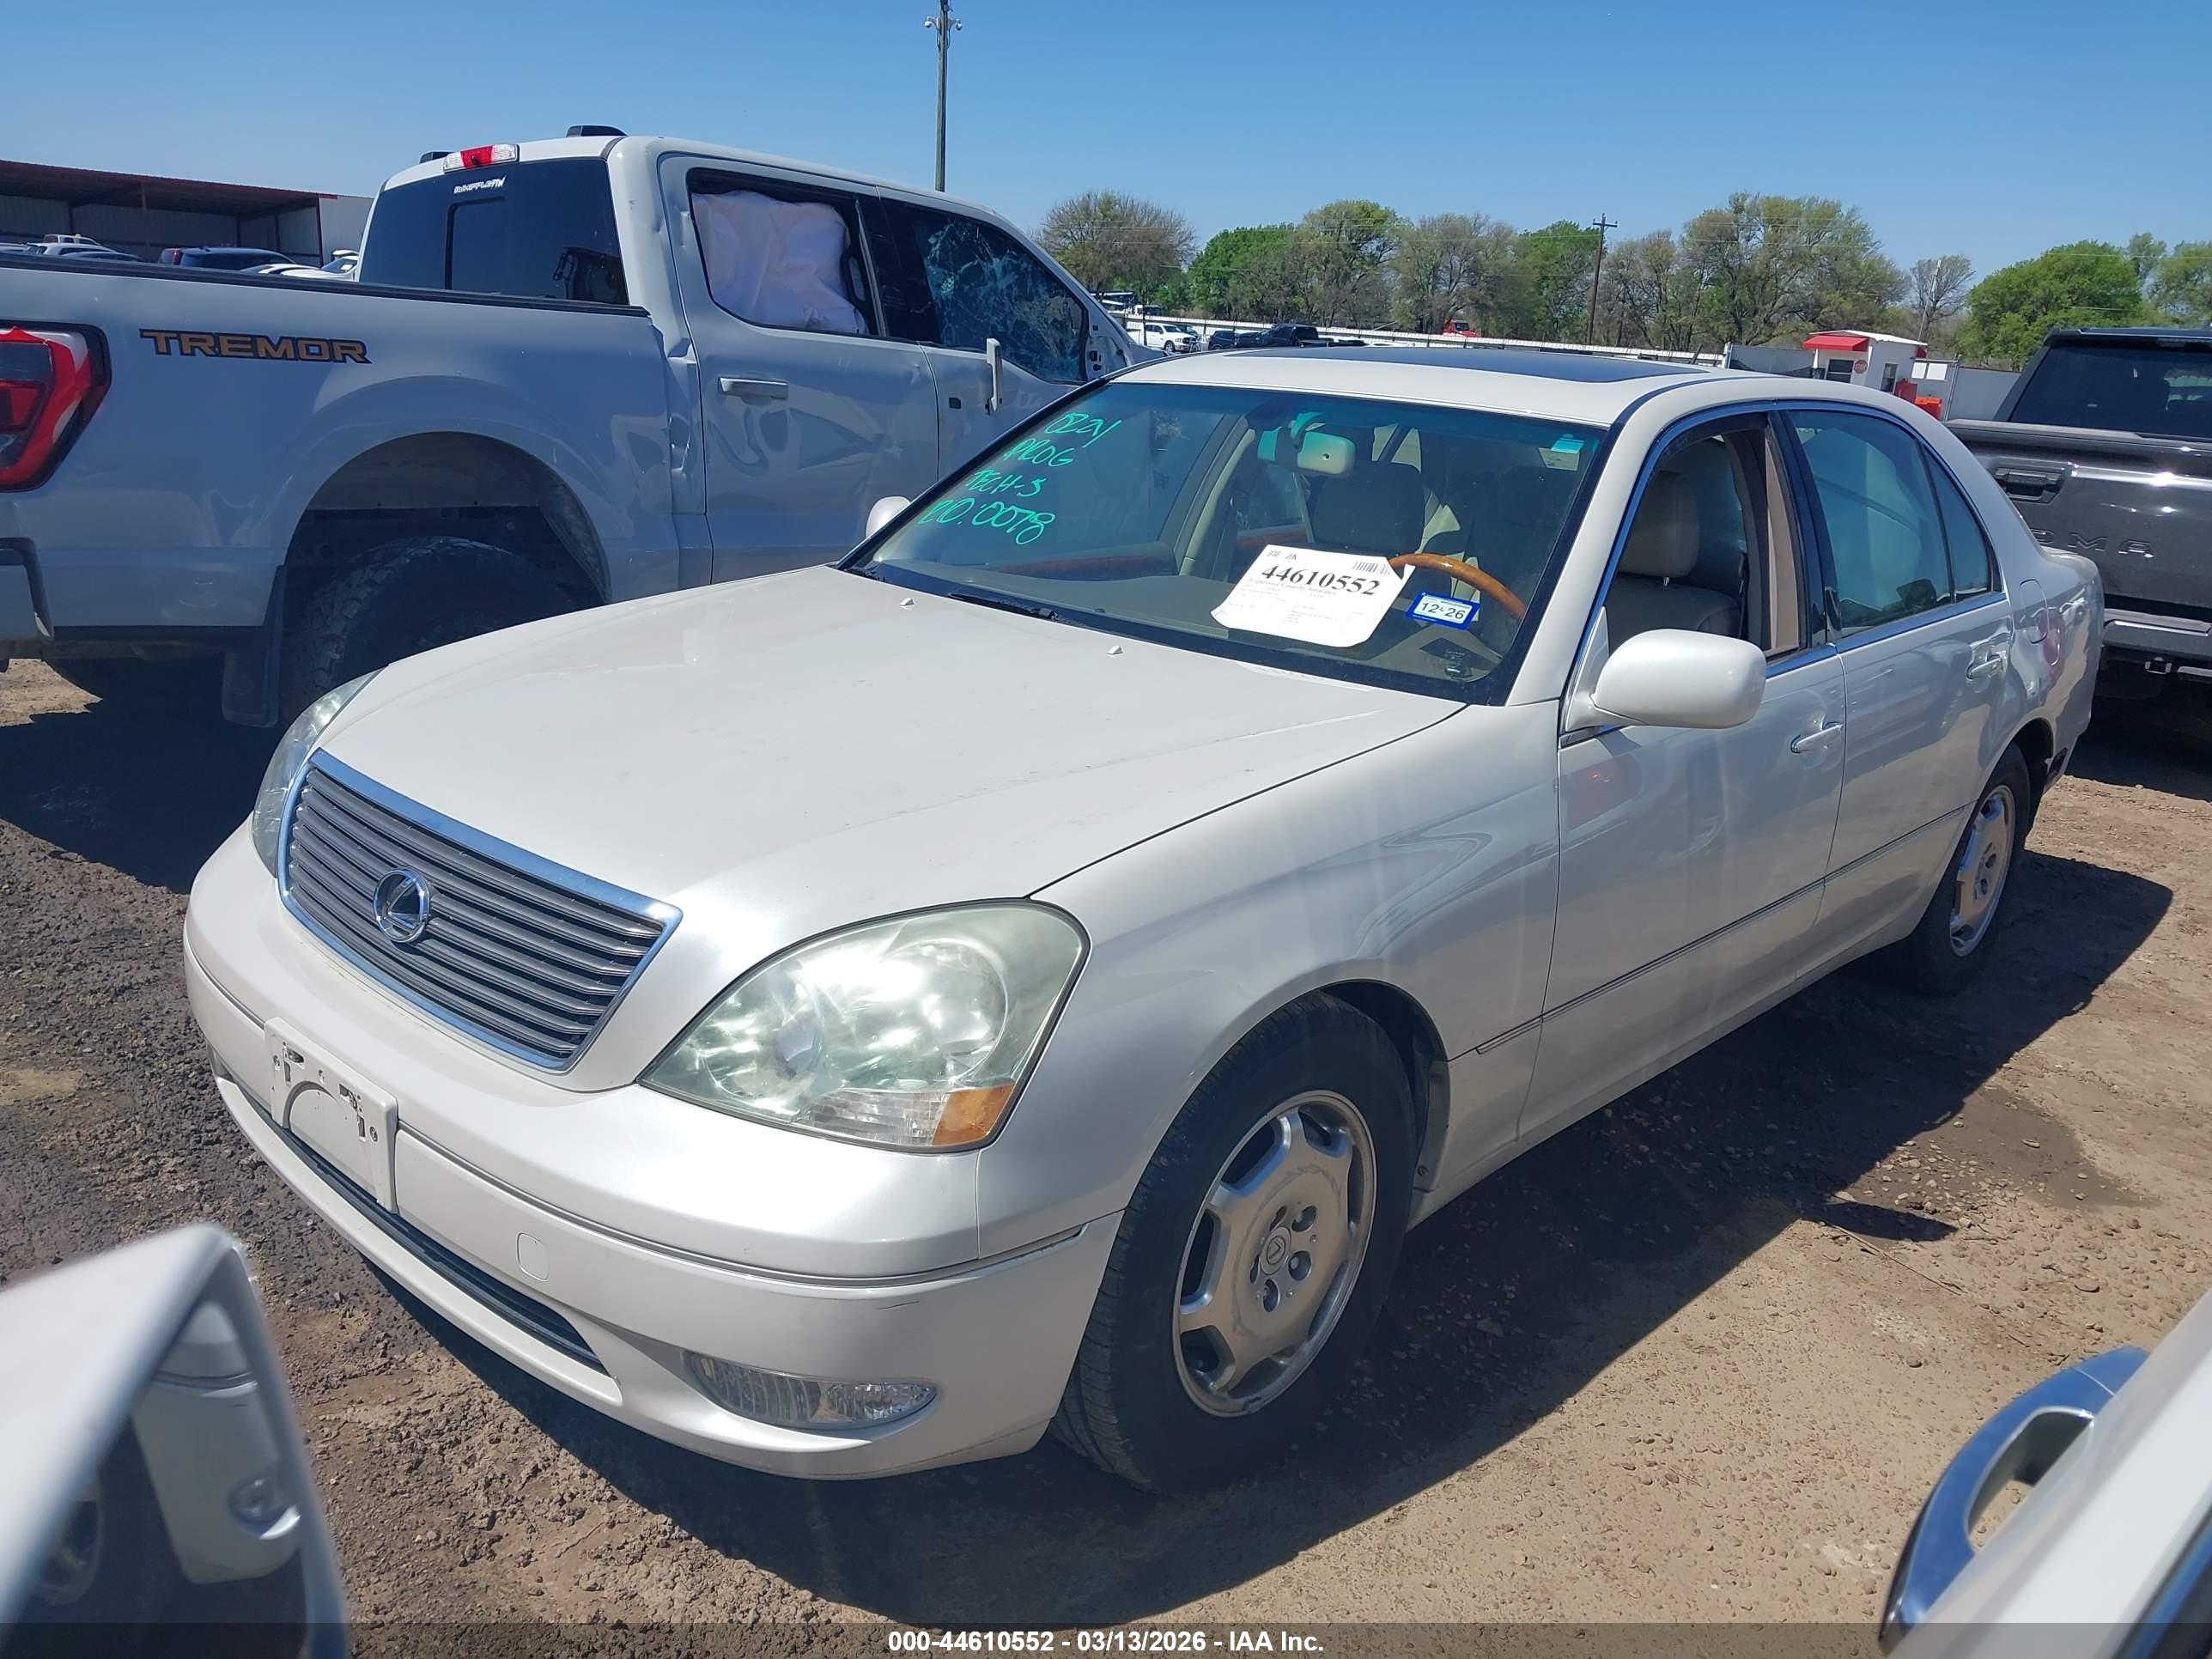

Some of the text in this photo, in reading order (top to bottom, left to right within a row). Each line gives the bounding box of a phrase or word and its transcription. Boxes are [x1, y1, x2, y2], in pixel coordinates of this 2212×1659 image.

[139, 328, 372, 364] TREMOR
[1003, 438, 1075, 467] PROG
[1261, 564, 1381, 596] 44610552
